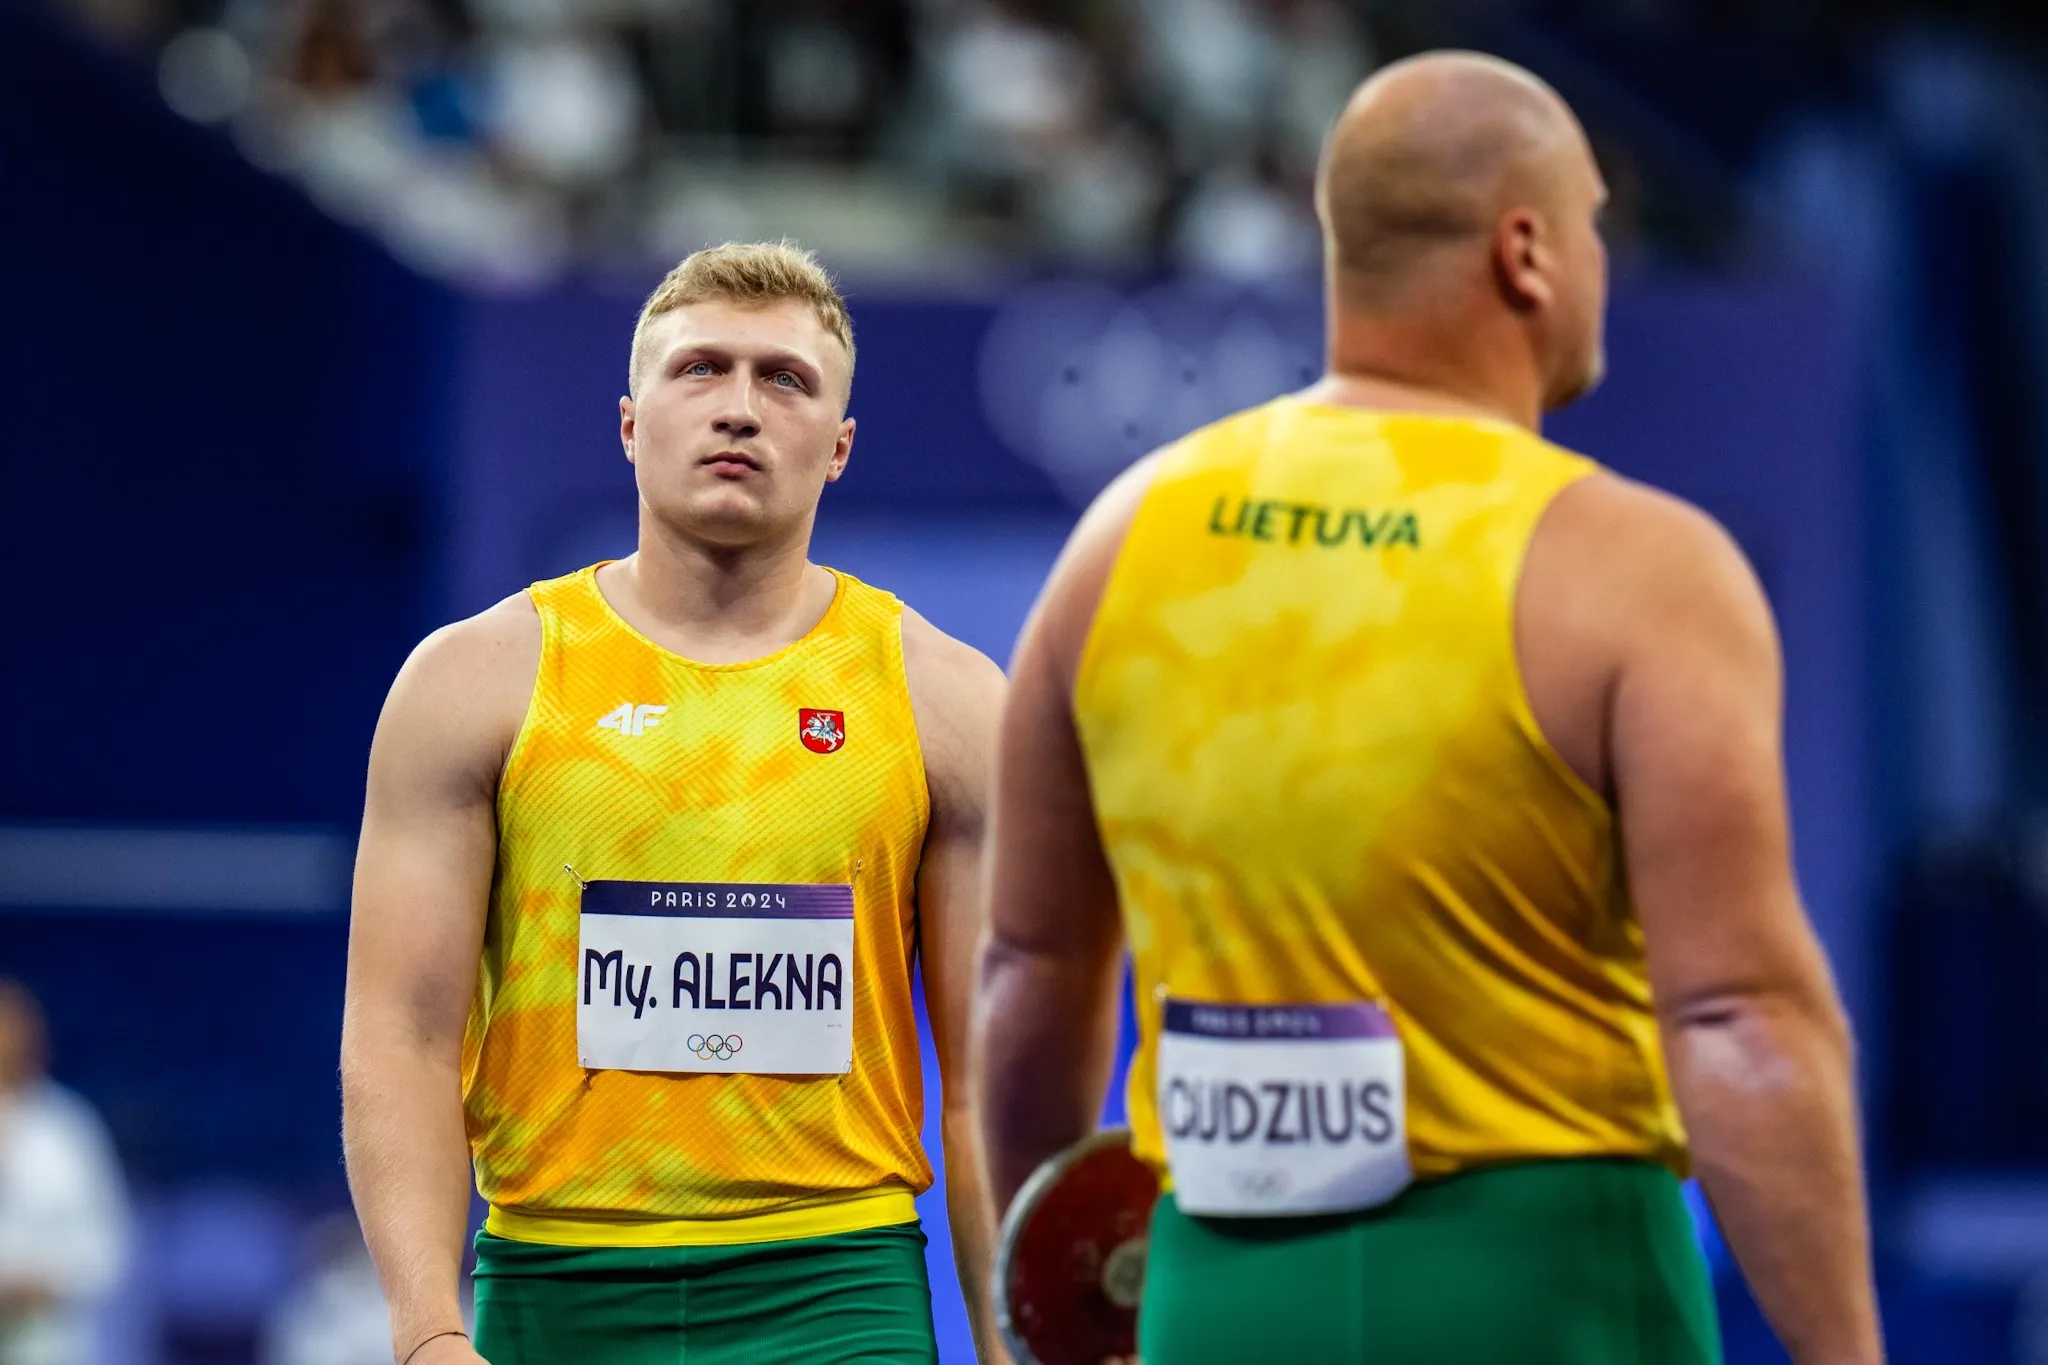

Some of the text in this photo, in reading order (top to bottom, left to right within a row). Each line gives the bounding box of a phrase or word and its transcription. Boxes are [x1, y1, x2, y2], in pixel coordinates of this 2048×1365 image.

[1207, 497, 1419, 549] LIETUVA
[597, 703, 668, 736] 4F
[651, 891, 786, 908] PARIS 2024
[584, 948, 842, 1019] My. ALEKNA
